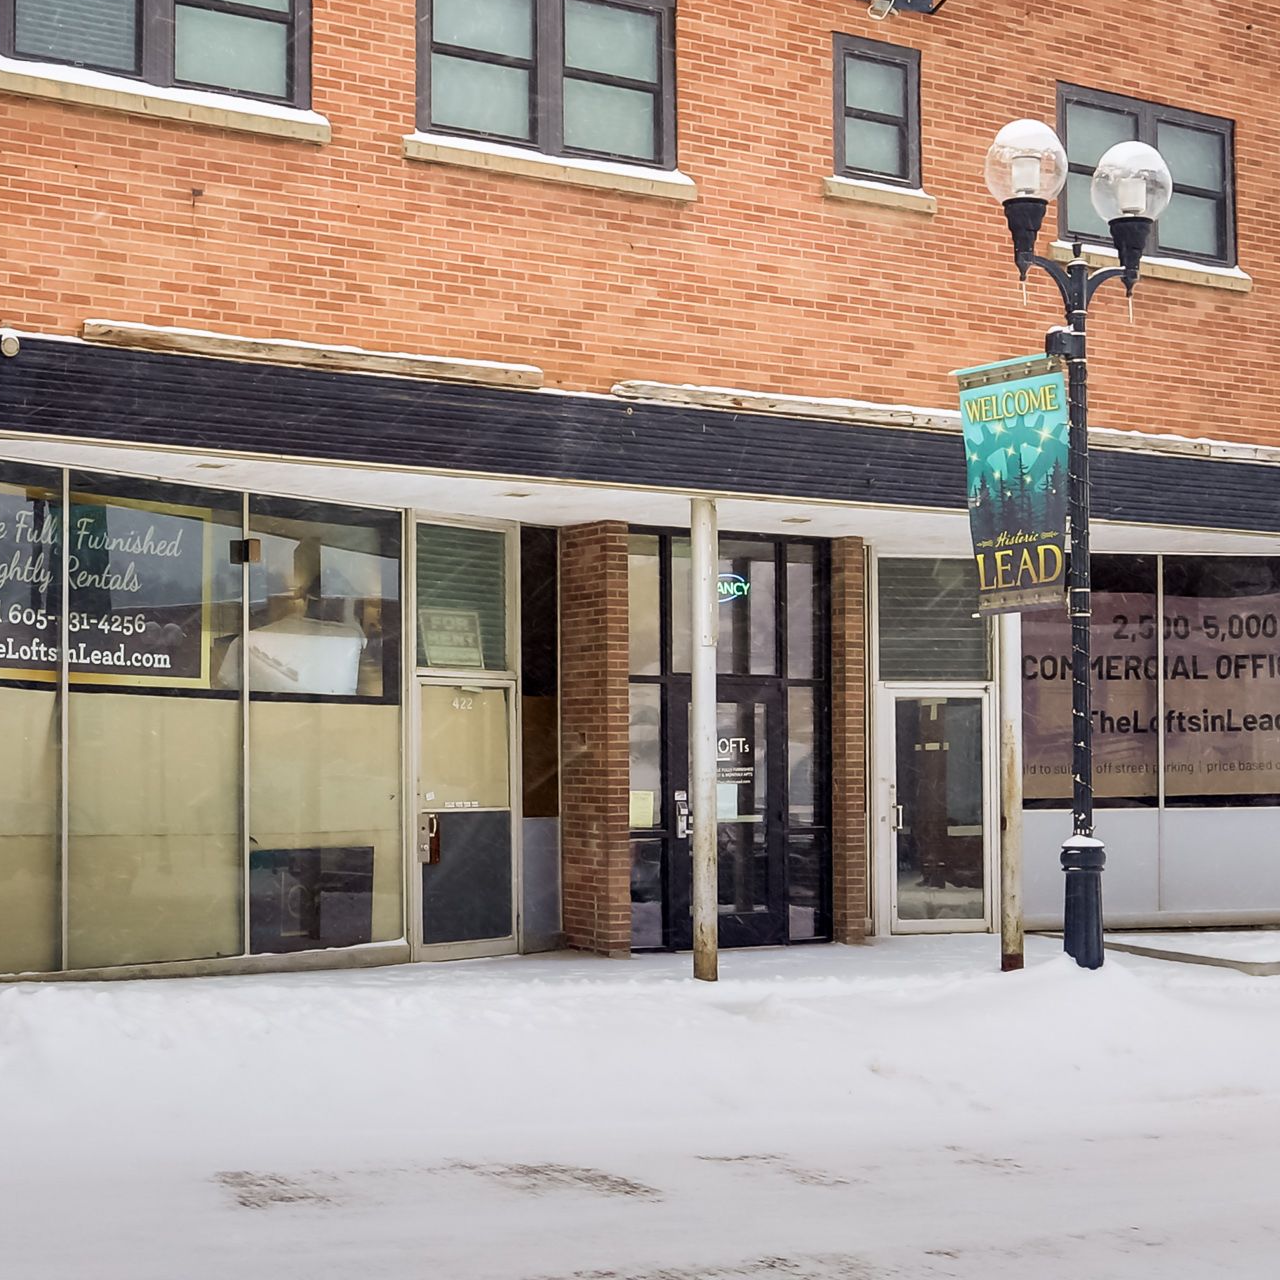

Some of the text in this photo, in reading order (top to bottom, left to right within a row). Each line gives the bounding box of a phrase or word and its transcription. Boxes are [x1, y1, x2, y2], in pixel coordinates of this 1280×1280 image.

[965, 384, 1059, 424] WELCOME
[15, 510, 61, 555] Full
[77, 517, 182, 557] Furnished
[995, 529, 1039, 548] Historic
[68, 555, 142, 592] Rentals
[976, 544, 1063, 591] LEAD
[717, 581, 750, 595] ANCY
[8, 603, 146, 636] 605-31-4256
[452, 697, 473, 710] 422
[1039, 764, 1052, 775] to
[1054, 763, 1073, 775] sui
[1096, 761, 1113, 774] off
[1115, 761, 1150, 774] street
[1152, 761, 1194, 776] prking
[1206, 761, 1235, 774] price
[1238, 759, 1273, 771] based
